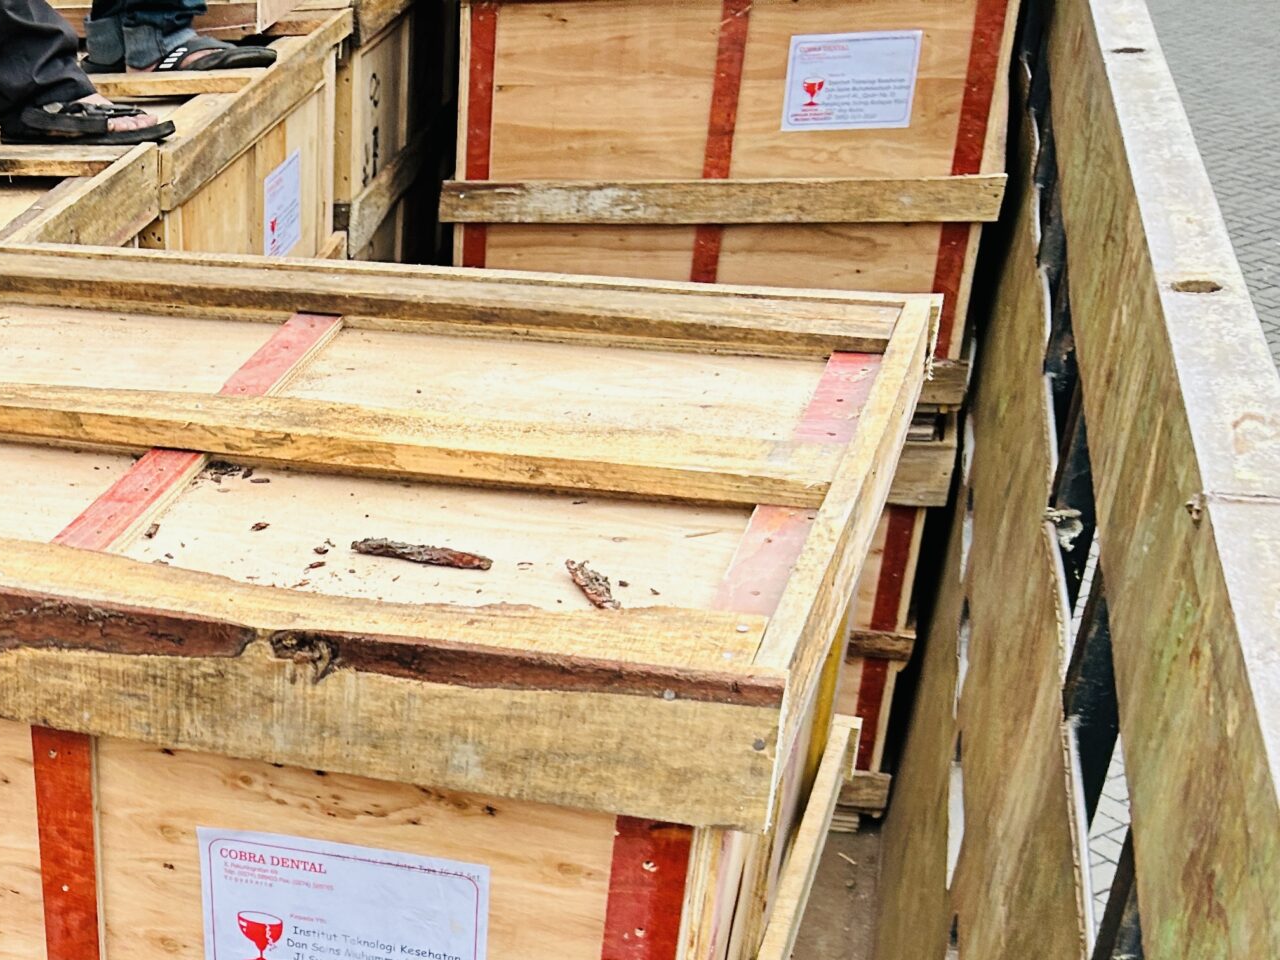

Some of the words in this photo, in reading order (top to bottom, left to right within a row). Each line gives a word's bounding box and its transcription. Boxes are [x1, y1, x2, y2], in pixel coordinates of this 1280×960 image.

[220, 848, 266, 865] COBRA
[270, 855, 327, 874] DENTAL
[286, 938, 308, 950] Dan
[293, 926, 338, 941] Institut
[341, 934, 396, 953] Teknologi
